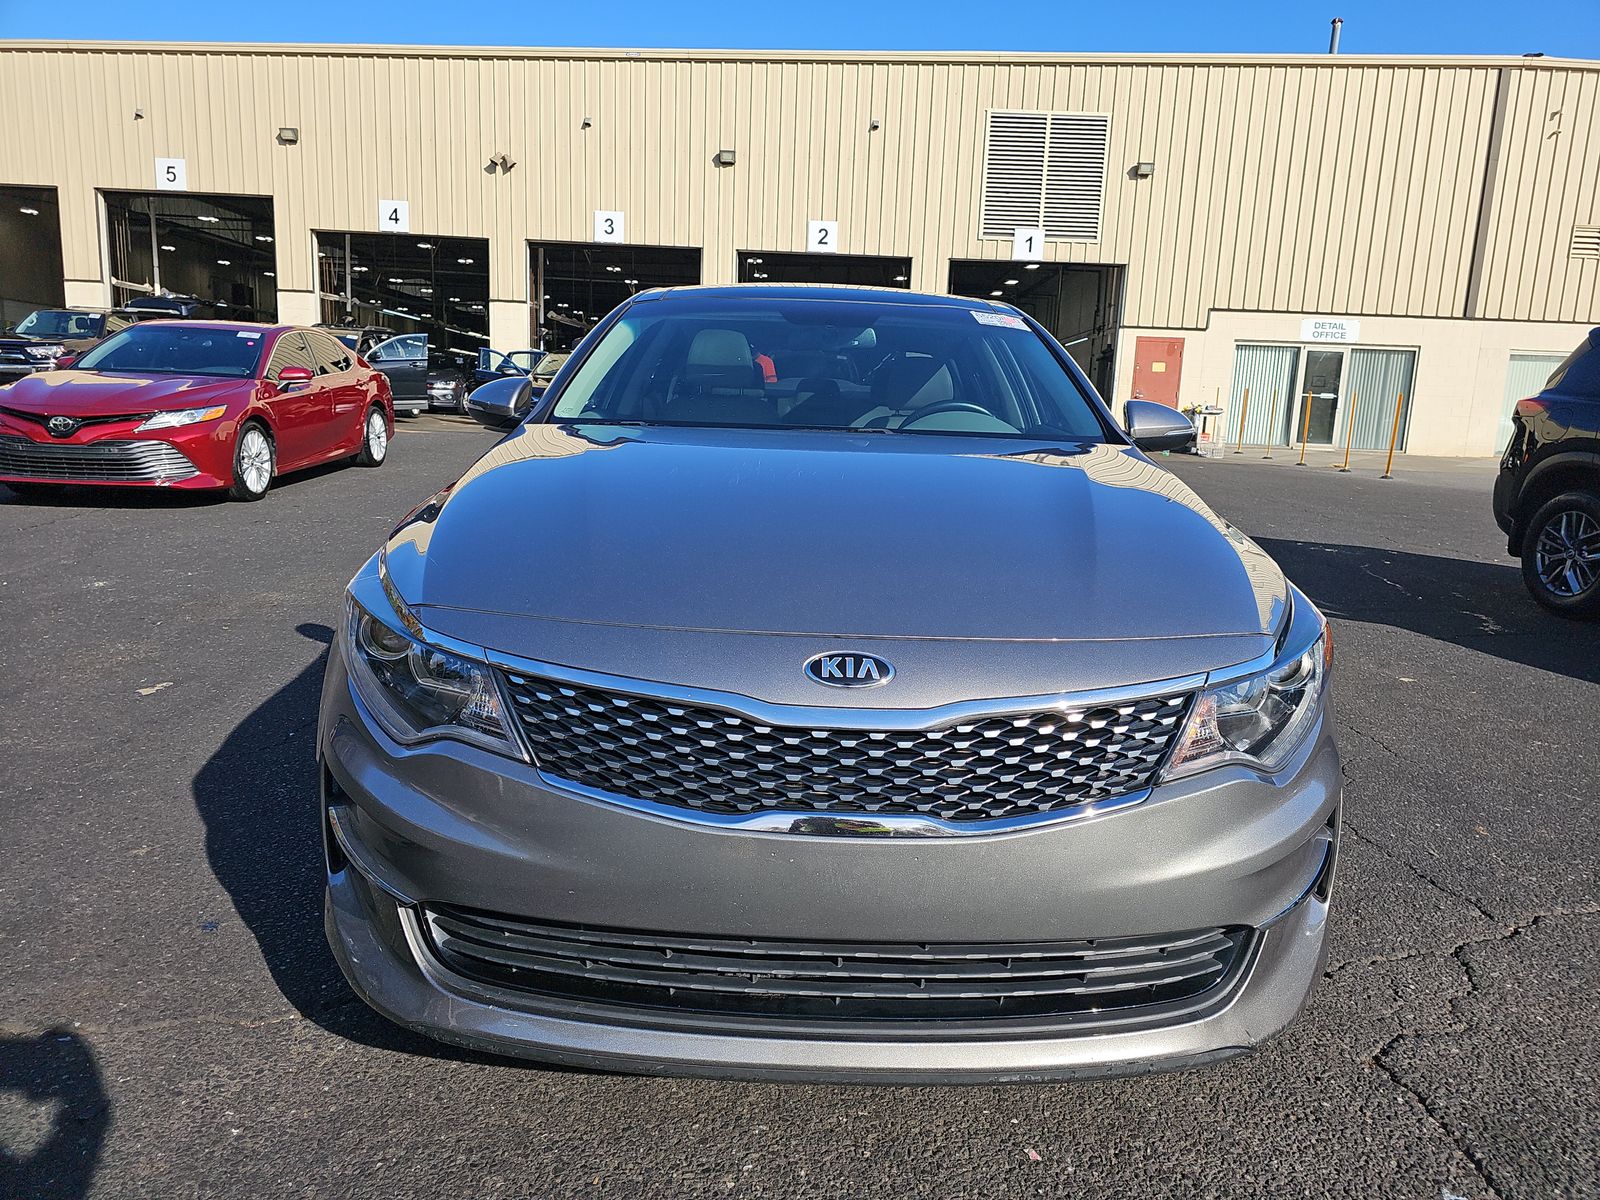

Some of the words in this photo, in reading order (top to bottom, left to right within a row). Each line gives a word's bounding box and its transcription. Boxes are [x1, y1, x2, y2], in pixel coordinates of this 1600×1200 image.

[166, 165, 177, 182] 5
[388, 208, 400, 225] 4
[604, 218, 615, 235] 3
[817, 228, 829, 245] 2
[1025, 236, 1033, 253] 1
[1314, 321, 1346, 330] DETAIL
[1312, 331, 1347, 340] OFFICE
[820, 656, 881, 680] KIA
